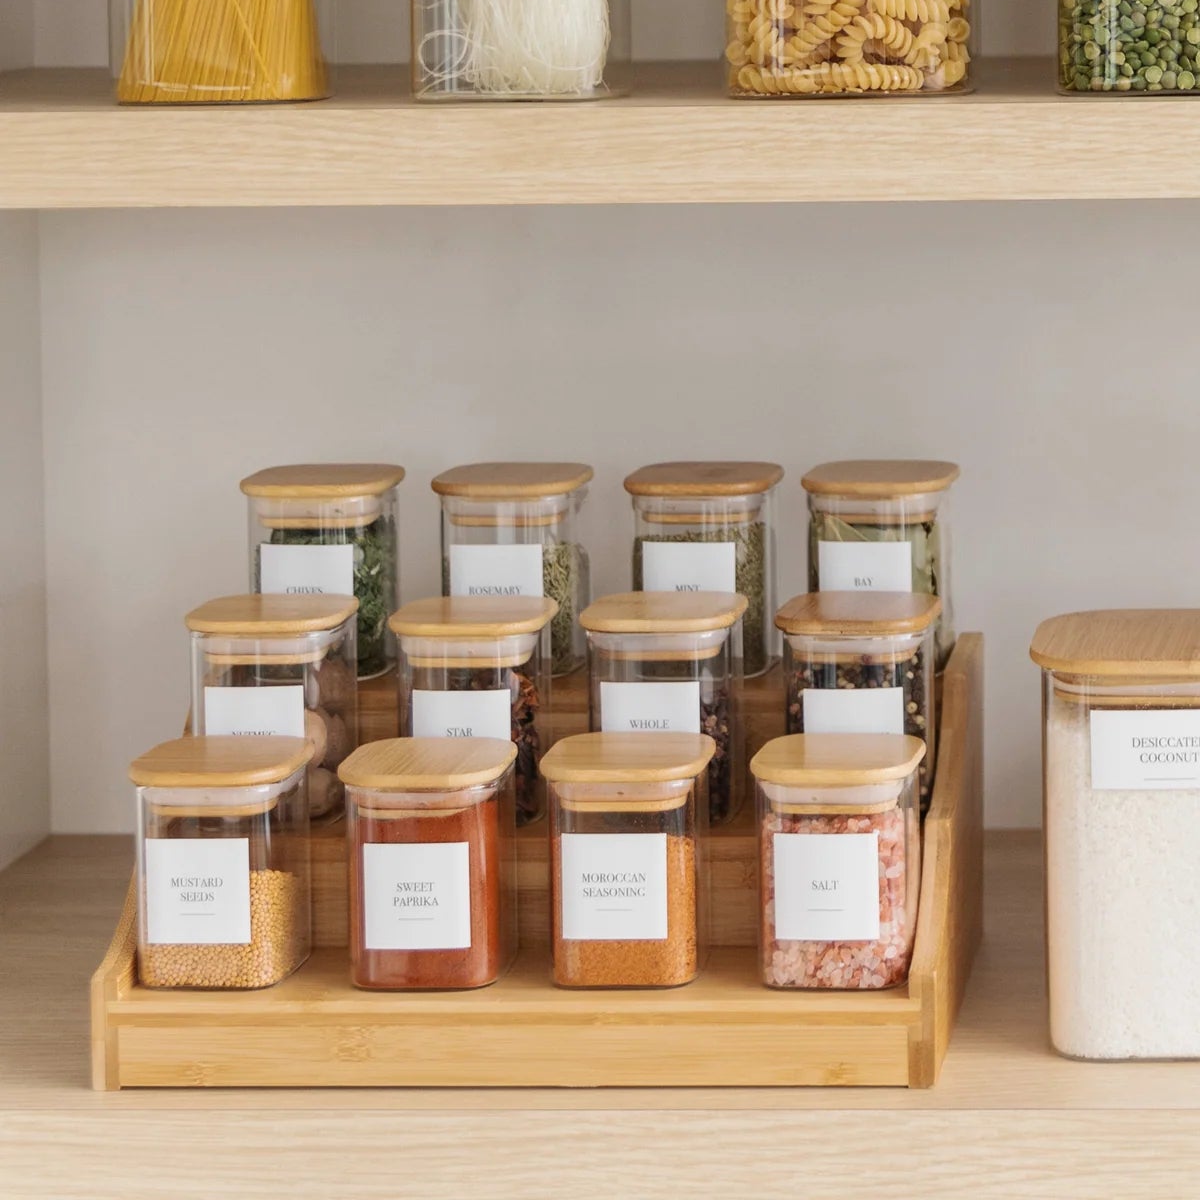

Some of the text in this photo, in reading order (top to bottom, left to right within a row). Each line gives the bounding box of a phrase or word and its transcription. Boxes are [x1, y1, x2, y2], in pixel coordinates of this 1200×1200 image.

[853, 578, 873, 588] BAY
[468, 586, 521, 596] ROSEMARY
[628, 719, 671, 730] WHOLE
[446, 728, 473, 738] STAR
[1139, 752, 1198, 764] COCONUT
[170, 878, 224, 888] MUSTARD
[581, 873, 647, 884] MOROCCAN
[396, 882, 435, 893] SWEET
[810, 880, 840, 891] SALT
[179, 892, 215, 903] SEEDS
[581, 888, 647, 899] SEASONING
[393, 897, 439, 907] PAPRIKA
